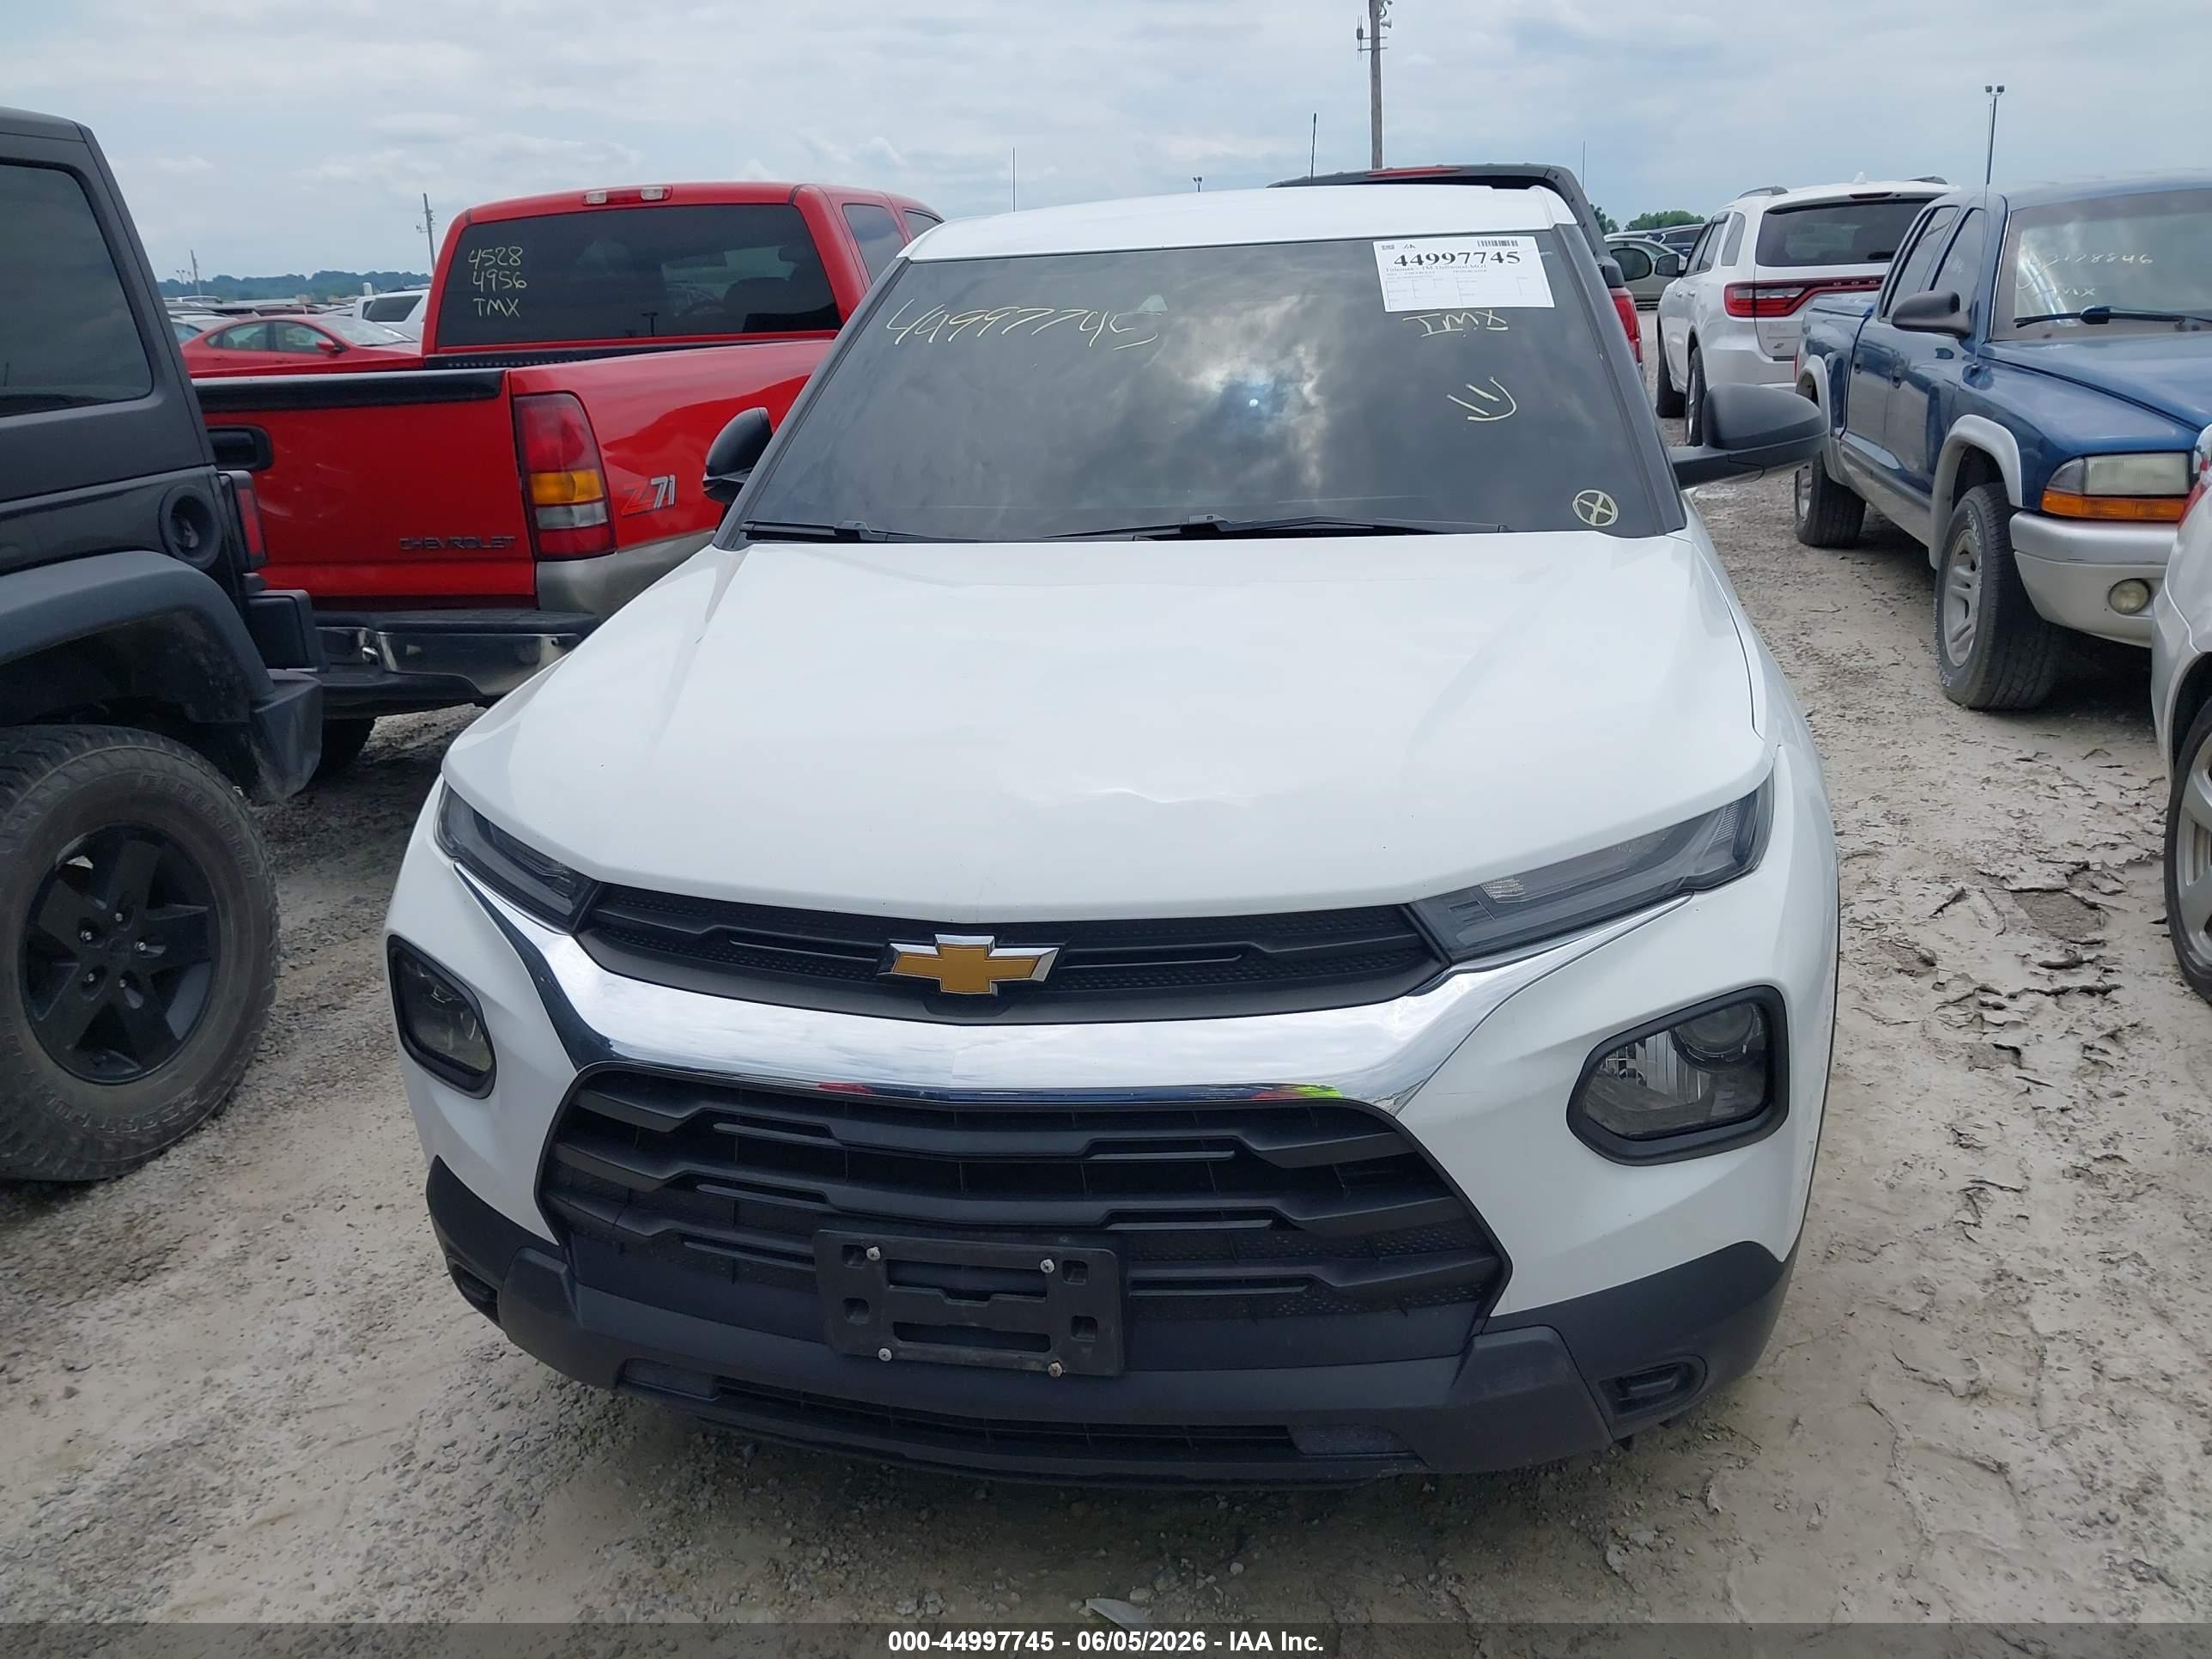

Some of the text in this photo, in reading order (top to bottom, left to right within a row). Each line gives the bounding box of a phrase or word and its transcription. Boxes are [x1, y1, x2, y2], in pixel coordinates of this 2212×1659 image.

[468, 246, 523, 270] 4528
[1394, 251, 1521, 266] 44997745
[473, 269, 527, 292] 4956
[473, 298, 520, 318] TMX
[621, 474, 676, 516] Z71
[398, 536, 516, 550] CHEVROLET
